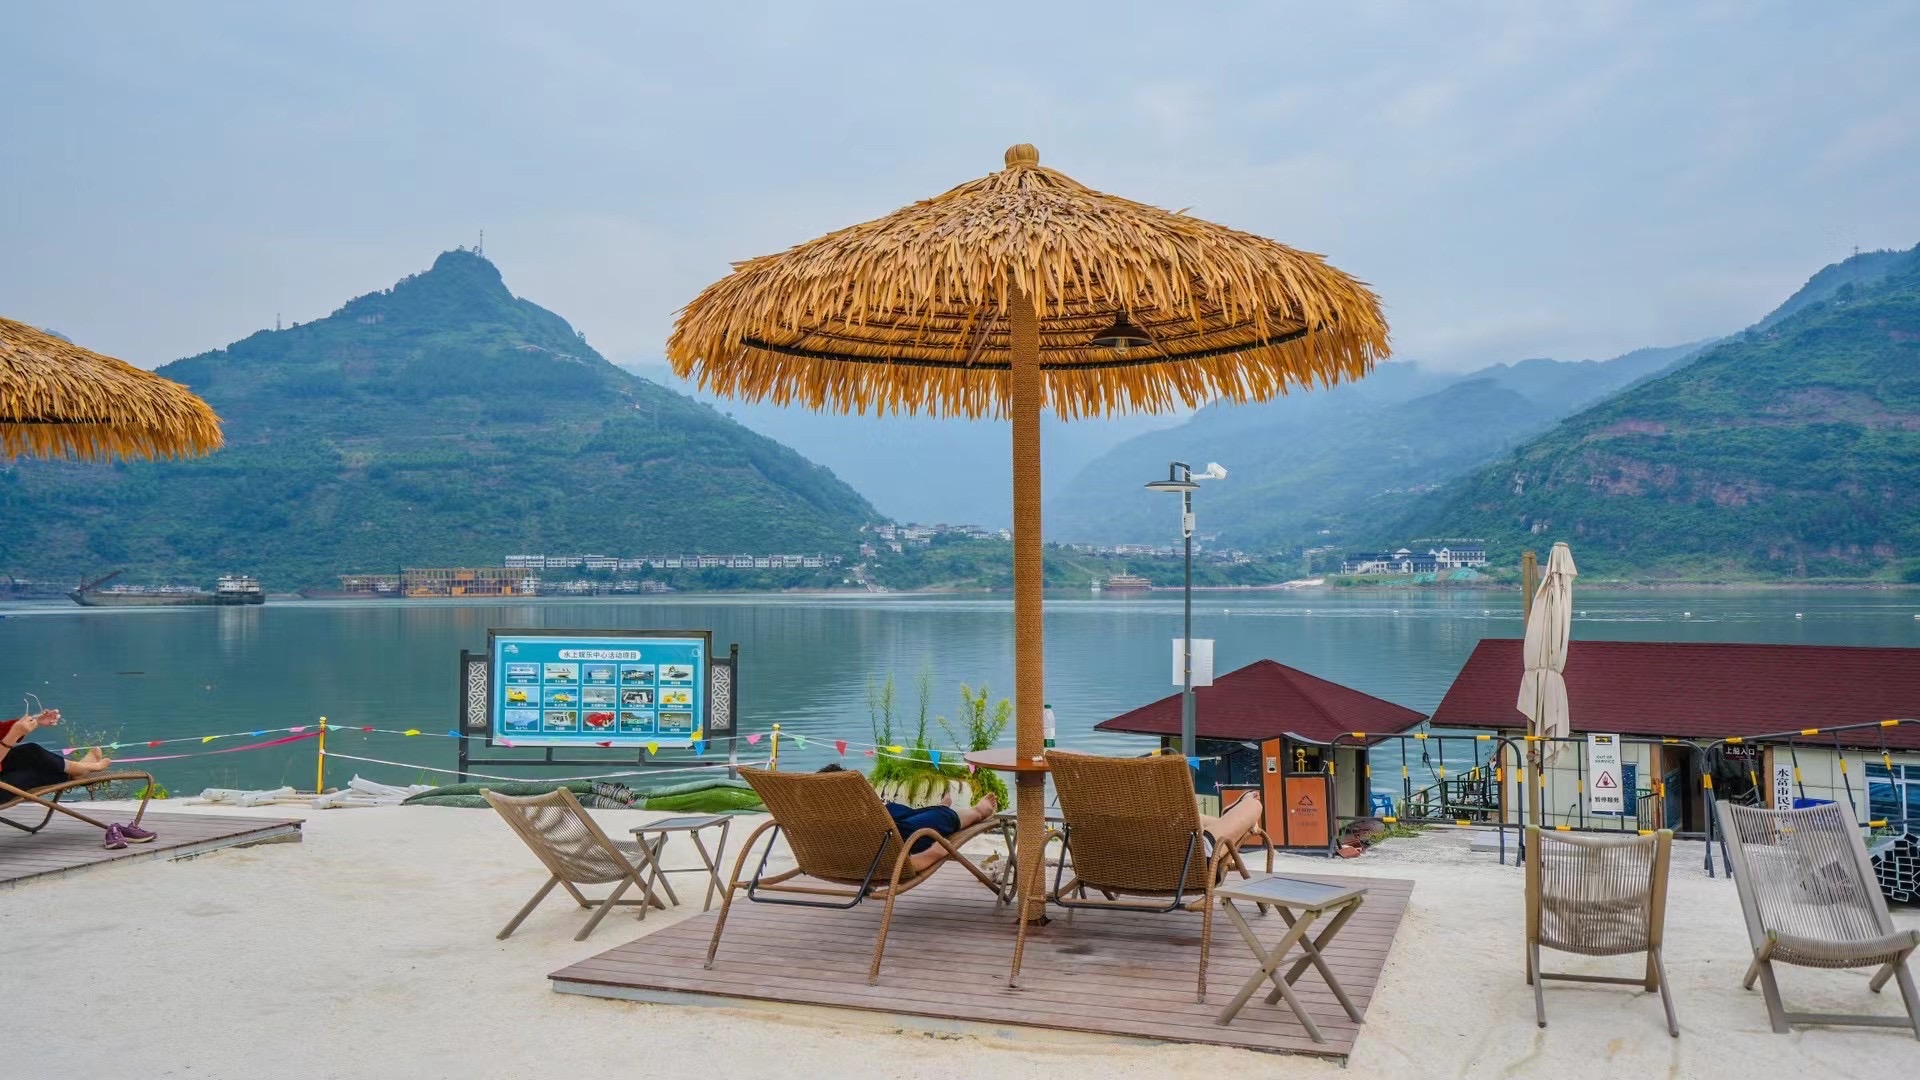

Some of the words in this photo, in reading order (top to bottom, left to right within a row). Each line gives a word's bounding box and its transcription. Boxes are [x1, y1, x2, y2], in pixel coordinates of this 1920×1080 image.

[563, 651, 637, 660] 水上娱乐中心活动项目
[1725, 746, 1755, 756] 上船入口
[1594, 796, 1620, 804] 暂停服务
